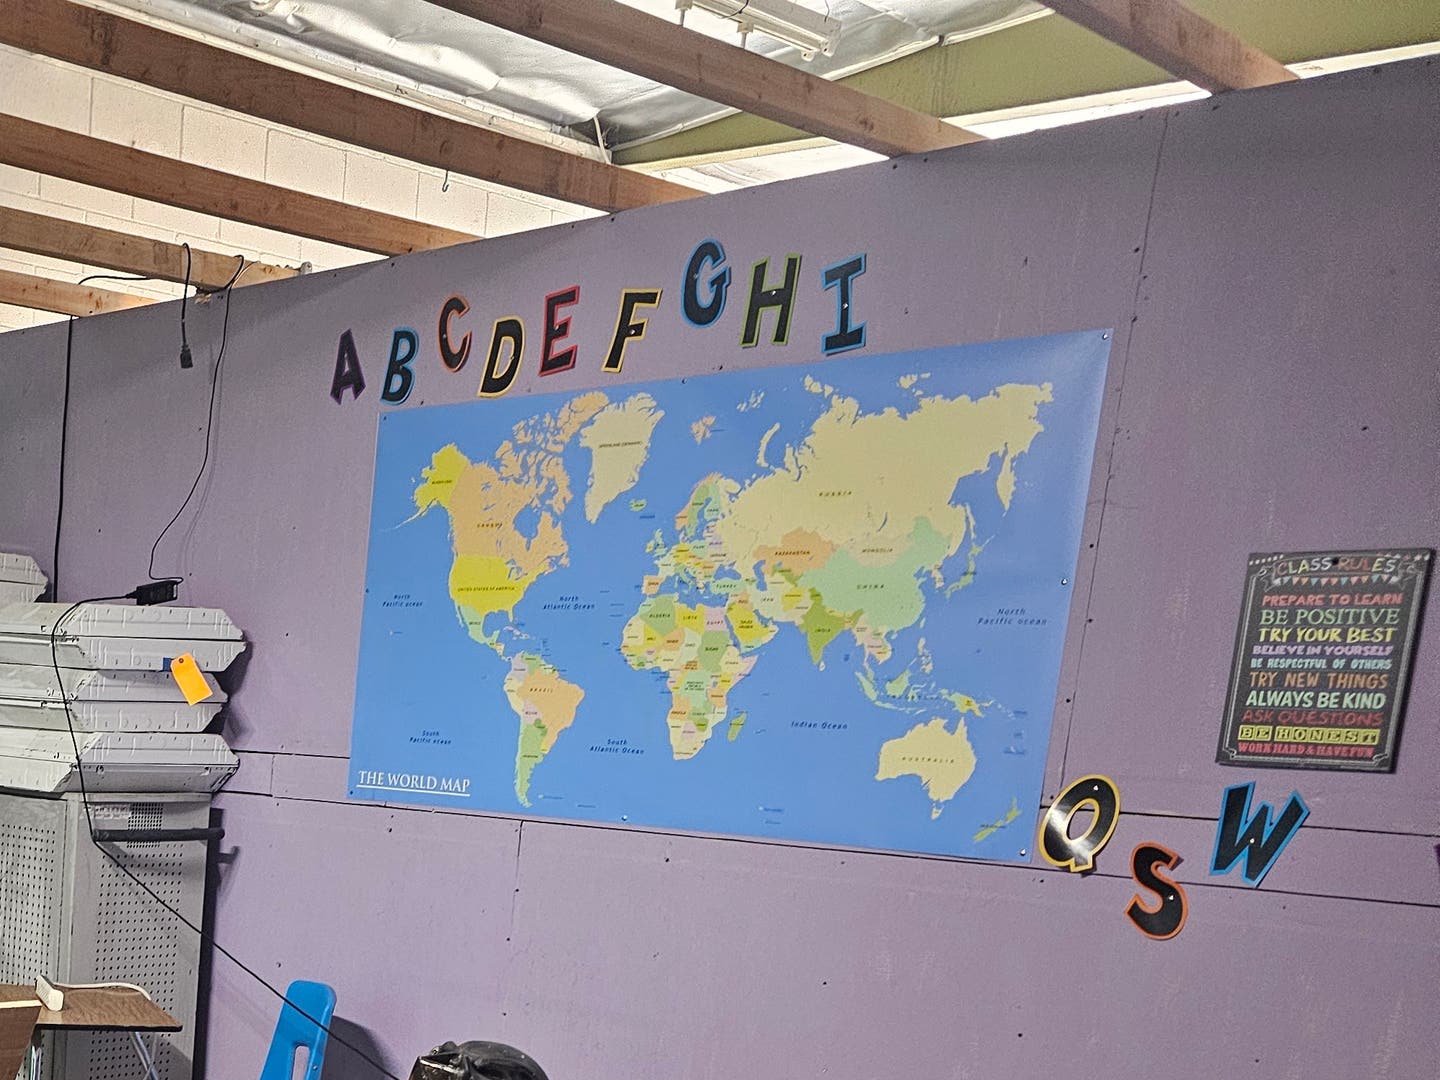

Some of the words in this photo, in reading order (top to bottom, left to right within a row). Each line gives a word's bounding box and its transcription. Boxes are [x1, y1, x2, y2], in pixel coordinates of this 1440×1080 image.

[330, 328, 366, 404] A
[380, 327, 419, 405] B
[438, 295, 472, 373] C
[477, 315, 527, 399] D
[538, 285, 581, 377] E
[601, 289, 663, 373] F
[681, 238, 731, 328] G
[740, 253, 802, 348] H
[821, 253, 867, 355] I
[1277, 557, 1332, 576] CLASS
[1338, 557, 1398, 573] RULES
[1262, 594, 1326, 607] PREPARE
[1329, 594, 1351, 606] TO
[1354, 592, 1405, 606] LEARN
[1260, 608, 1289, 625] BE
[1294, 608, 1401, 625] POSITIVE
[1258, 628, 1293, 642] TRY
[1296, 628, 1345, 643] YOUR
[1346, 627, 1398, 644] BEST
[1252, 645, 1304, 656] BELIEVE
[1305, 645, 1322, 655] IN
[1324, 646, 1394, 657] YOURSELF
[1250, 658, 1263, 668] BE
[1267, 658, 1327, 669] RESPECTFUL
[1332, 658, 1346, 669] OF
[1350, 659, 1393, 670] OTHERS
[1249, 671, 1277, 688] TRY
[1284, 672, 1320, 688] NEW
[1328, 672, 1390, 689] THINGS
[1246, 690, 1314, 708] ALWAYS
[1316, 692, 1340, 709] BE
[1342, 692, 1387, 710] KIND
[1242, 709, 1273, 724] ASK
[1278, 710, 1385, 726] QUESTIONS
[1239, 726, 1271, 740] BE
[1276, 727, 1379, 744] HONEST
[358, 770, 384, 785] THE
[387, 773, 437, 790] WORLD
[440, 777, 471, 792] MAP
[1038, 774, 1121, 873] Q
[1210, 780, 1310, 888] W
[1123, 841, 1188, 940] S
